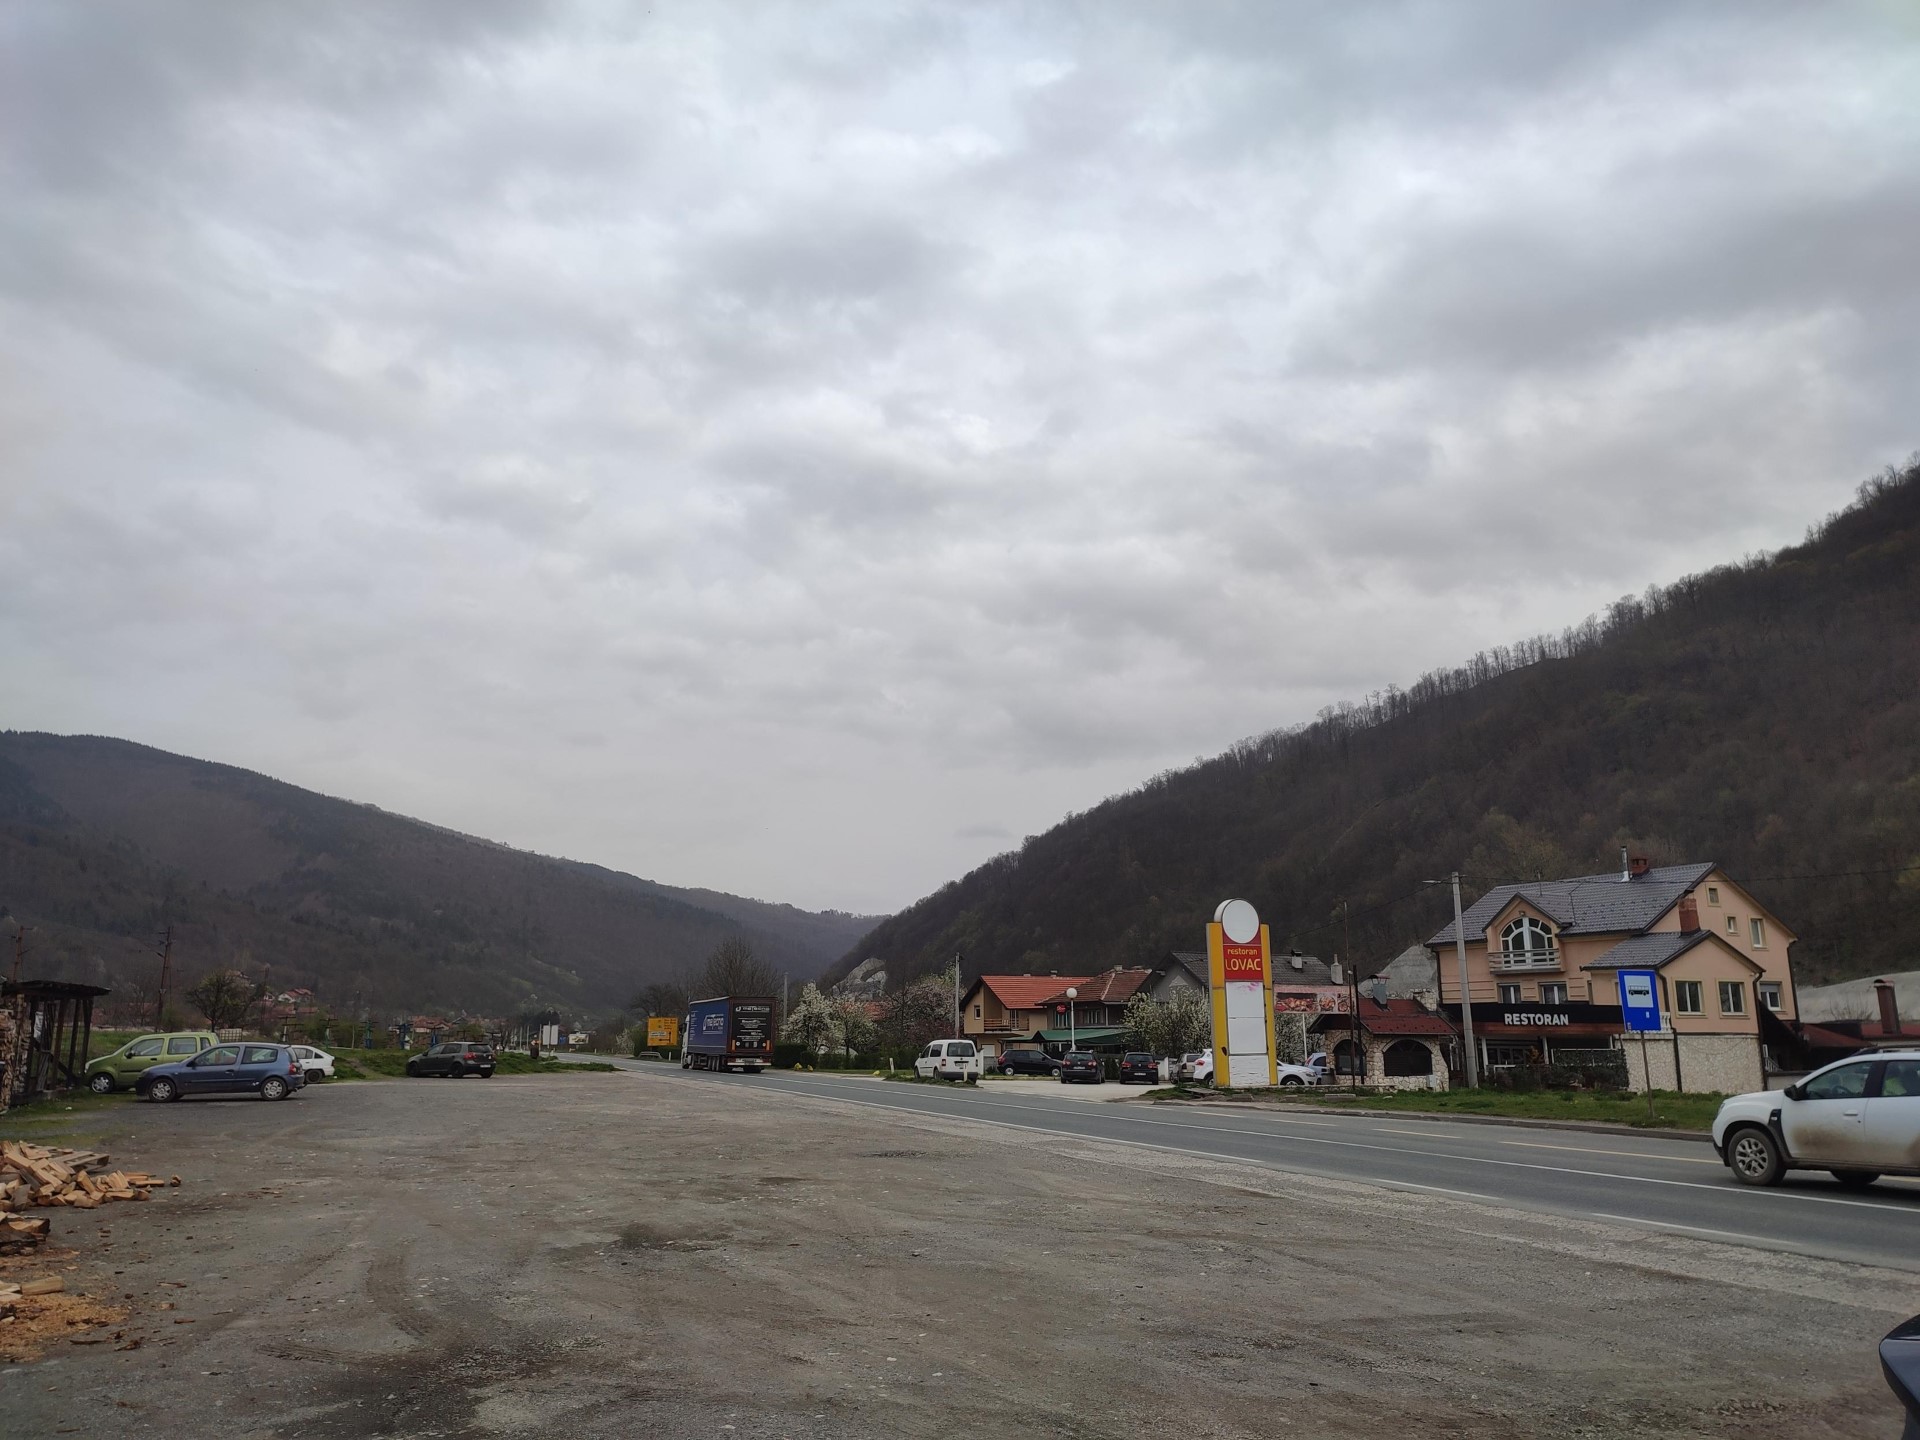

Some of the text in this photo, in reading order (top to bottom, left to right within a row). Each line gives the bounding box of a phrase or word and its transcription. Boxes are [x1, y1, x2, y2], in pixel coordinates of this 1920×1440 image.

[1227, 947, 1258, 955] restoran
[1225, 958, 1261, 970] LOVAC
[1504, 1013, 1569, 1025] RESTORAN
